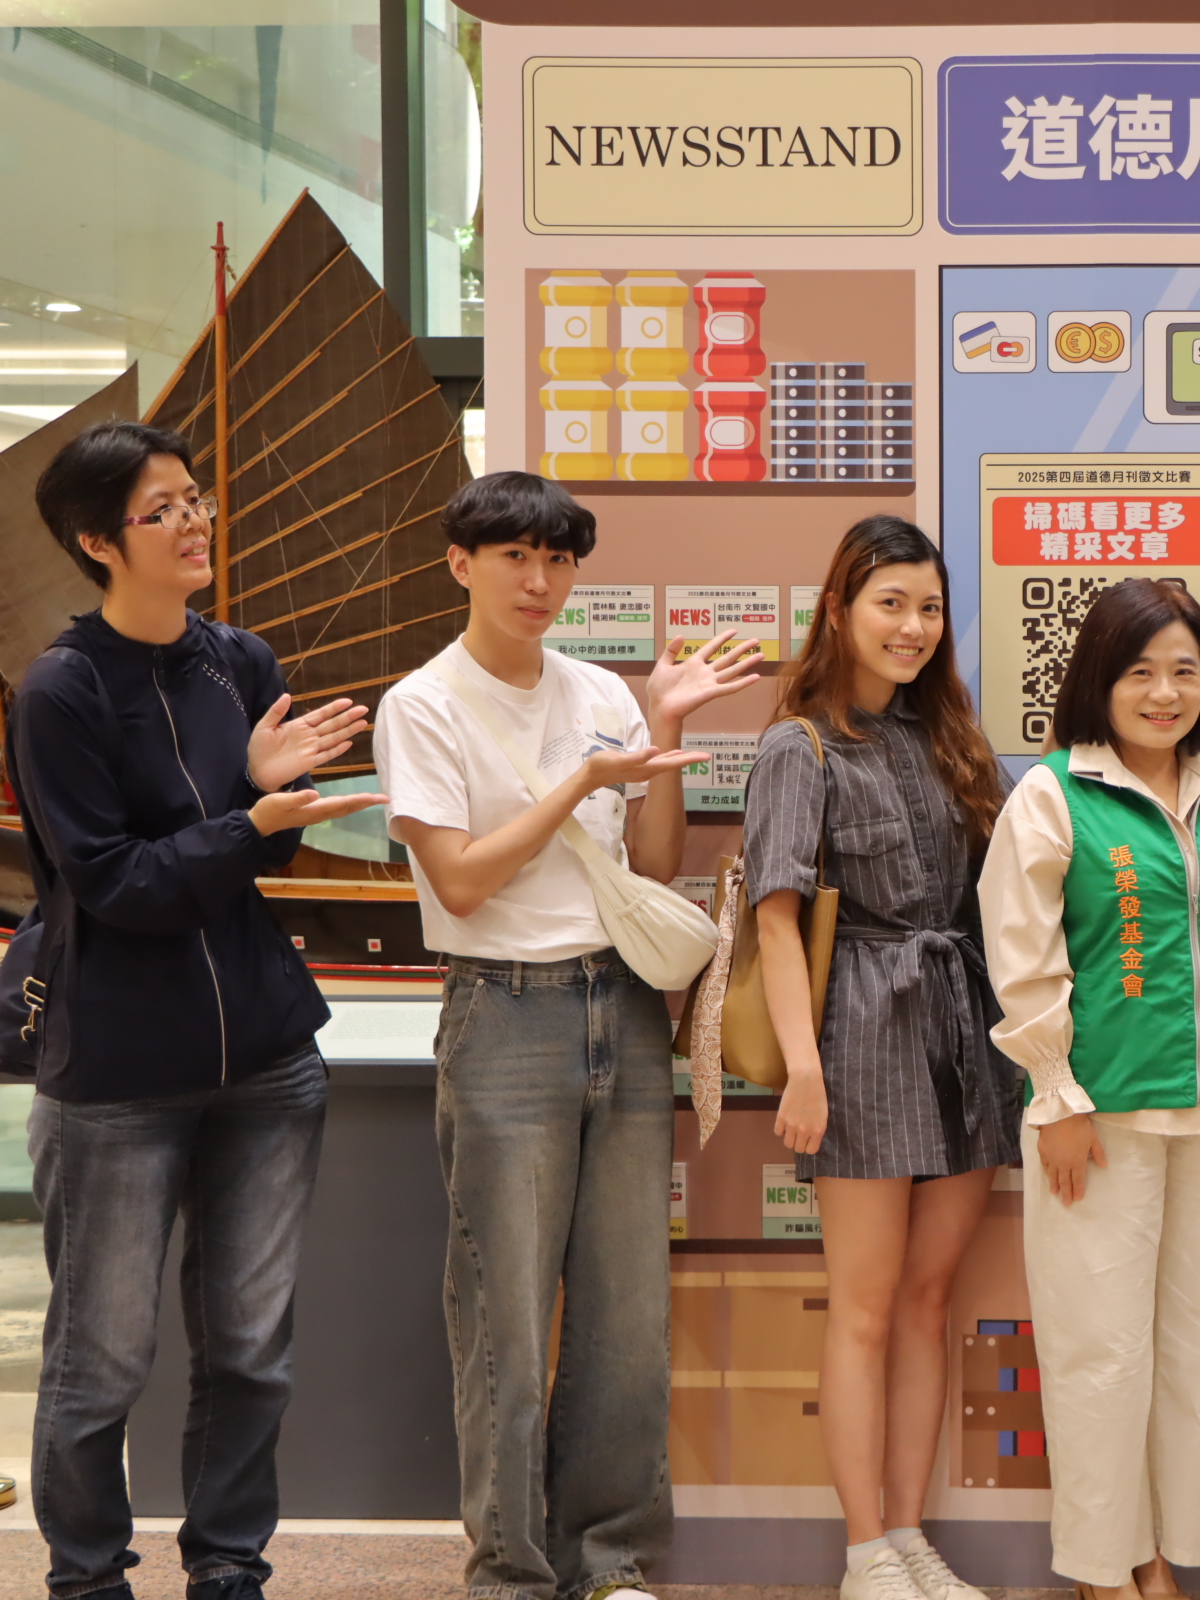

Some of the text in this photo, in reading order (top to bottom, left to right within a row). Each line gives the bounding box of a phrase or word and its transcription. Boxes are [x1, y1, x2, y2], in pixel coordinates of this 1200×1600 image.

[545, 124, 902, 168] NEWSSTAND
[1018, 470, 1191, 484] 2025第四屆道德月刊徵文比賽
[1023, 501, 1186, 531] 掃碼看更多
[1039, 531, 1169, 561] 精采文章
[718, 603, 776, 611] 台南市 文賢國中
[670, 609, 711, 626] NEWS
[558, 645, 636, 655] 我心中的道德標準
[701, 795, 740, 804] 眾力成城
[1109, 845, 1145, 998] 張榮發基金會
[766, 1187, 807, 1204] NEWS
